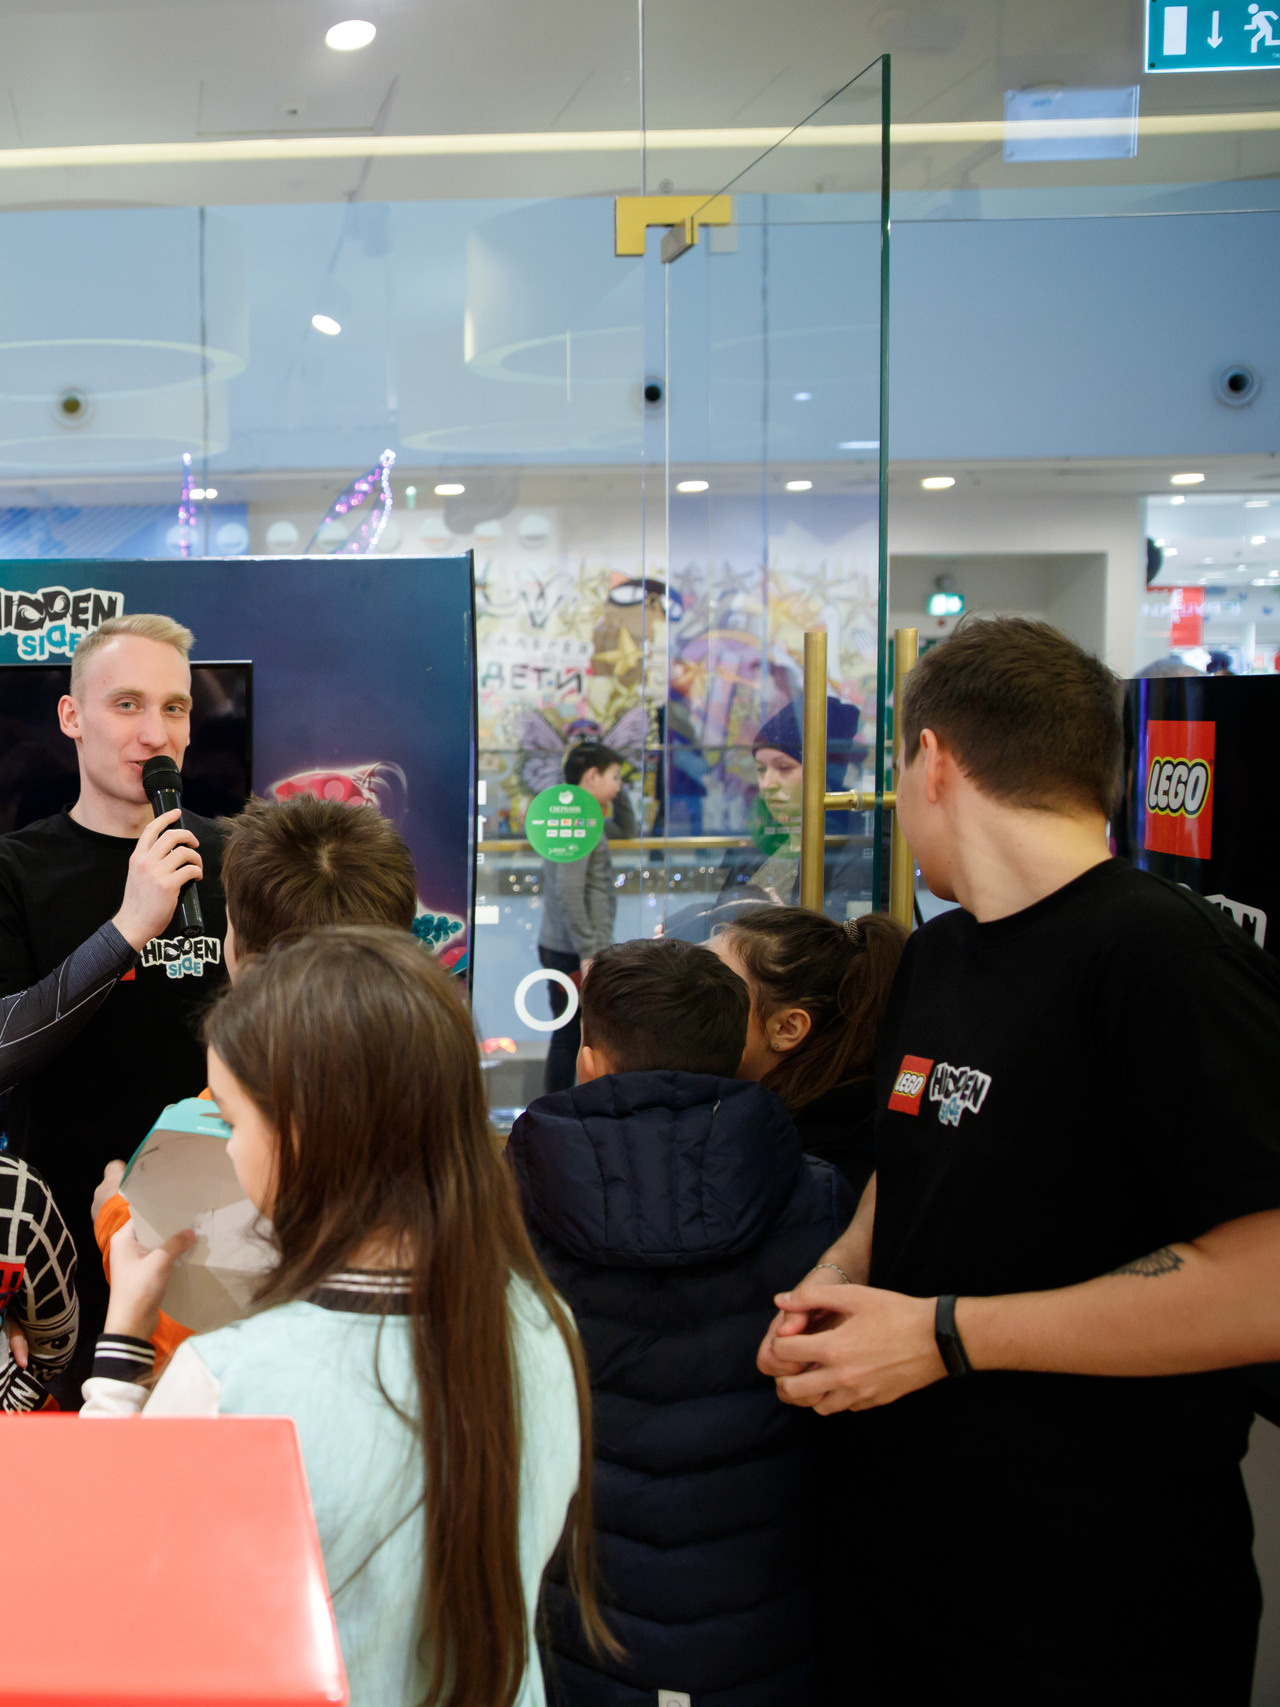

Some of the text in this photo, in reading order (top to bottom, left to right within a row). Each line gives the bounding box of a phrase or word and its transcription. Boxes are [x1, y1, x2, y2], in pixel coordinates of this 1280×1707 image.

[1148, 760, 1208, 815] LEGO
[142, 938, 219, 963] HIDDEN
[168, 957, 201, 976] SIDE
[895, 1072, 925, 1096] LEGO
[931, 1063, 989, 1111] HIDDEN
